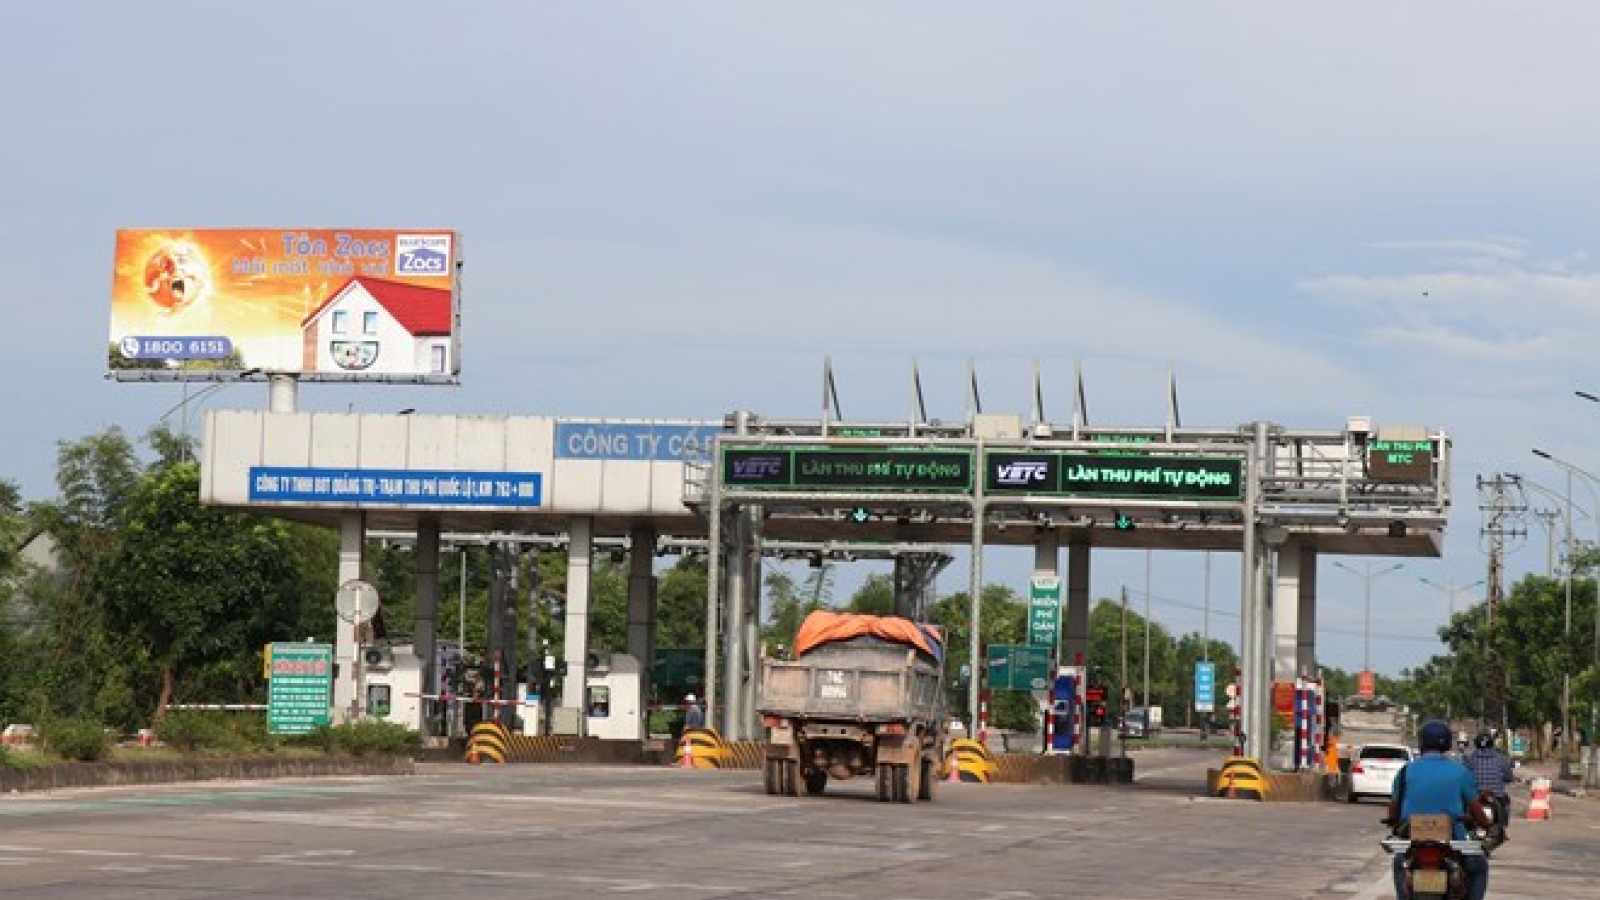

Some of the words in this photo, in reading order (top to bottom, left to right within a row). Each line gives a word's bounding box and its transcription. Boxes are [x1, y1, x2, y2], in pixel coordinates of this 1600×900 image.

[282, 232, 327, 256] Tôn
[335, 233, 390, 258] Zacs
[404, 254, 442, 270] Zacs
[145, 340, 183, 354] 1800
[189, 340, 224, 354] 6151
[568, 428, 629, 454] CÔNG
[635, 434, 662, 455] TY
[802, 460, 833, 475] LÀN
[834, 463, 864, 475] THU
[917, 460, 961, 480] ĐỘNG
[1068, 464, 1098, 481] LÀN
[1100, 466, 1132, 482] THU
[1134, 466, 1160, 483] PHÍ
[1163, 468, 1184, 487] TỰ
[1185, 466, 1232, 487] ĐỘNG
